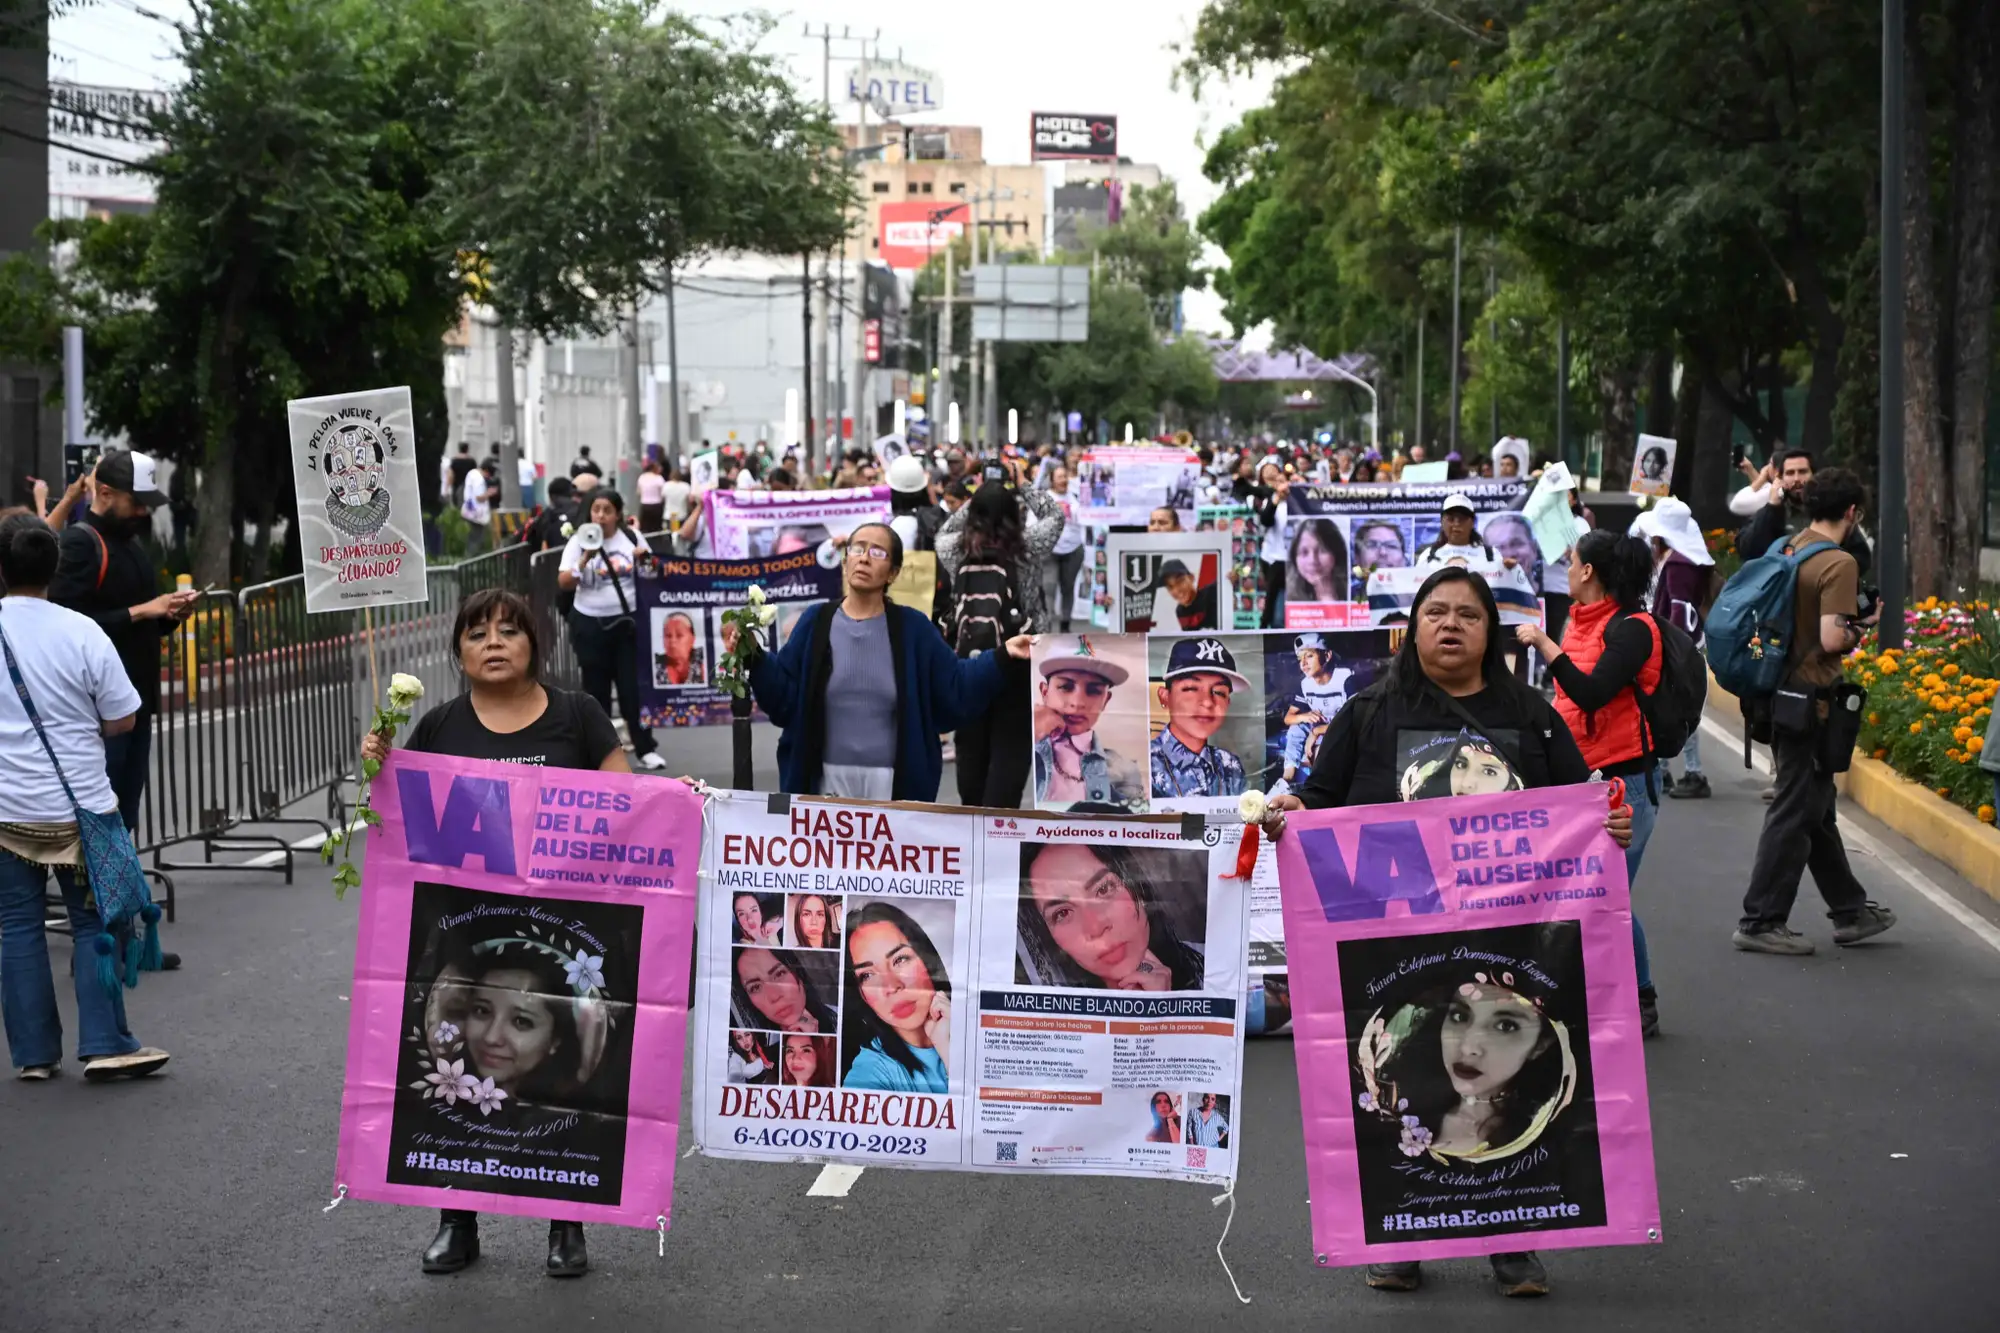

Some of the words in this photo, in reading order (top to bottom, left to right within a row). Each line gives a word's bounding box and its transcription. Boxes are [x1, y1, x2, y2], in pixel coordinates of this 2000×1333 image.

[1036, 117, 1092, 131] HOTEL
[338, 408, 372, 420] VUELVE
[374, 416, 382, 427] A
[309, 414, 338, 449] PELOTA
[308, 455, 316, 470] LA
[1391, 487, 1402, 498] A
[1322, 502, 1368, 511] Denuncia
[320, 540, 407, 564] DESAPARECIDOS
[694, 562, 760, 577] ESTAMOS
[763, 552, 816, 574] TODOS!
[338, 558, 402, 584] ¿CUÁNDO?
[1130, 557, 1142, 580] 1
[660, 591, 724, 604] GUADALUPE
[764, 582, 818, 599] ONZÁLEZ
[540, 787, 632, 813] VOCES
[395, 768, 517, 876] VA
[536, 812, 569, 832] DE
[575, 816, 610, 836] LA
[791, 808, 894, 842] HASTA
[1036, 826, 1104, 838] Ayúdanos
[1122, 828, 1183, 840] localizar
[1449, 809, 1550, 836] VOCES
[532, 841, 674, 867] AUSENCIA
[723, 834, 961, 875] ENCONTRARTE
[1451, 840, 1490, 862] DE
[1494, 837, 1532, 858] LA
[530, 868, 596, 884] JUSTICIA
[600, 874, 609, 884] Y
[614, 875, 674, 890] VERDAD
[718, 869, 810, 890] MARLENNE
[814, 874, 884, 894] BLANDO
[887, 877, 964, 897] AGUIRRE
[1297, 820, 1446, 923] VA
[1455, 856, 1604, 887] AUSENCIA
[1458, 896, 1526, 910] JUSTICIA
[1528, 895, 1540, 904] Y
[1544, 887, 1606, 903] VERDAD
[1004, 995, 1082, 1012] MARLENNE
[1086, 998, 1144, 1014] BLANDO
[1148, 1000, 1212, 1014] AGUIRRE
[1068, 1022, 1092, 1030] hechos
[718, 1086, 956, 1130] DESAPARECIDA
[1058, 1093, 1092, 1101] búsqueda
[734, 1126, 927, 1156] 6-AGOSTO-2023
[406, 1152, 600, 1187] #HastaEcontrarte
[1508, 1146, 1548, 1178] 2018
[1382, 1202, 1581, 1231] #HastaEcontrarte
